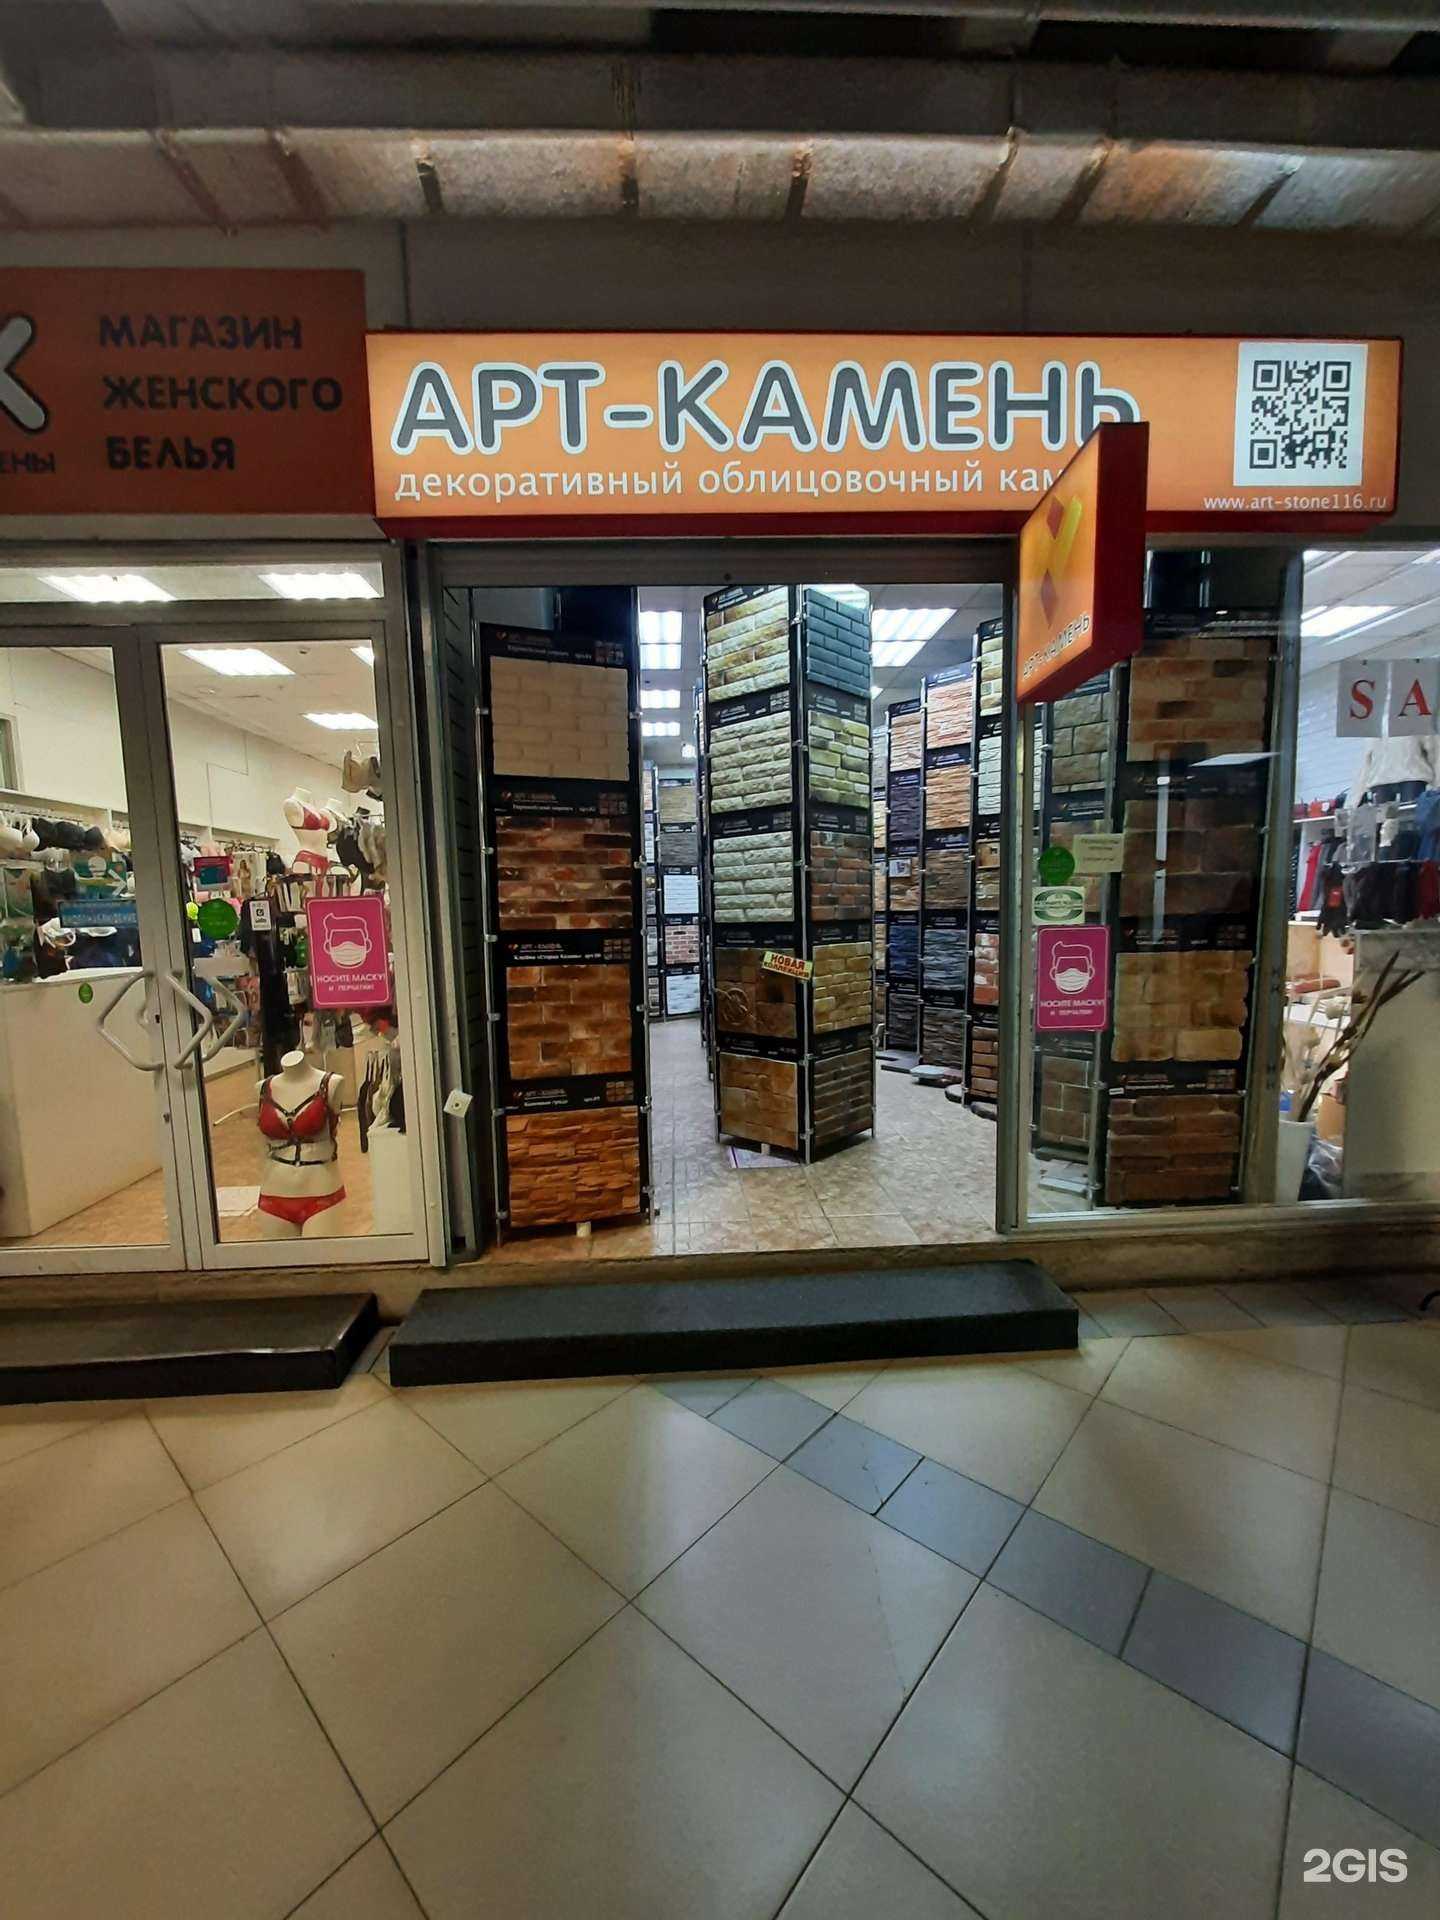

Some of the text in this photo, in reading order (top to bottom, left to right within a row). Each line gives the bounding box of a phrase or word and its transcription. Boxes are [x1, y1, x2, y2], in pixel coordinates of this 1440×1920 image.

[99, 315, 303, 349] МАГАЗИН
[102, 376, 343, 412] ЖЕНСКОГО
[390, 360, 1142, 455] АРТ-КАМЕНЬ
[106, 437, 236, 470] БЕЛЬЯ
[394, 461, 683, 502] декоративный
[698, 460, 984, 497] облицовочный
[1204, 493, 1387, 511] www.art-stone116.ru
[771, 954, 805, 970] НОВАЯ
